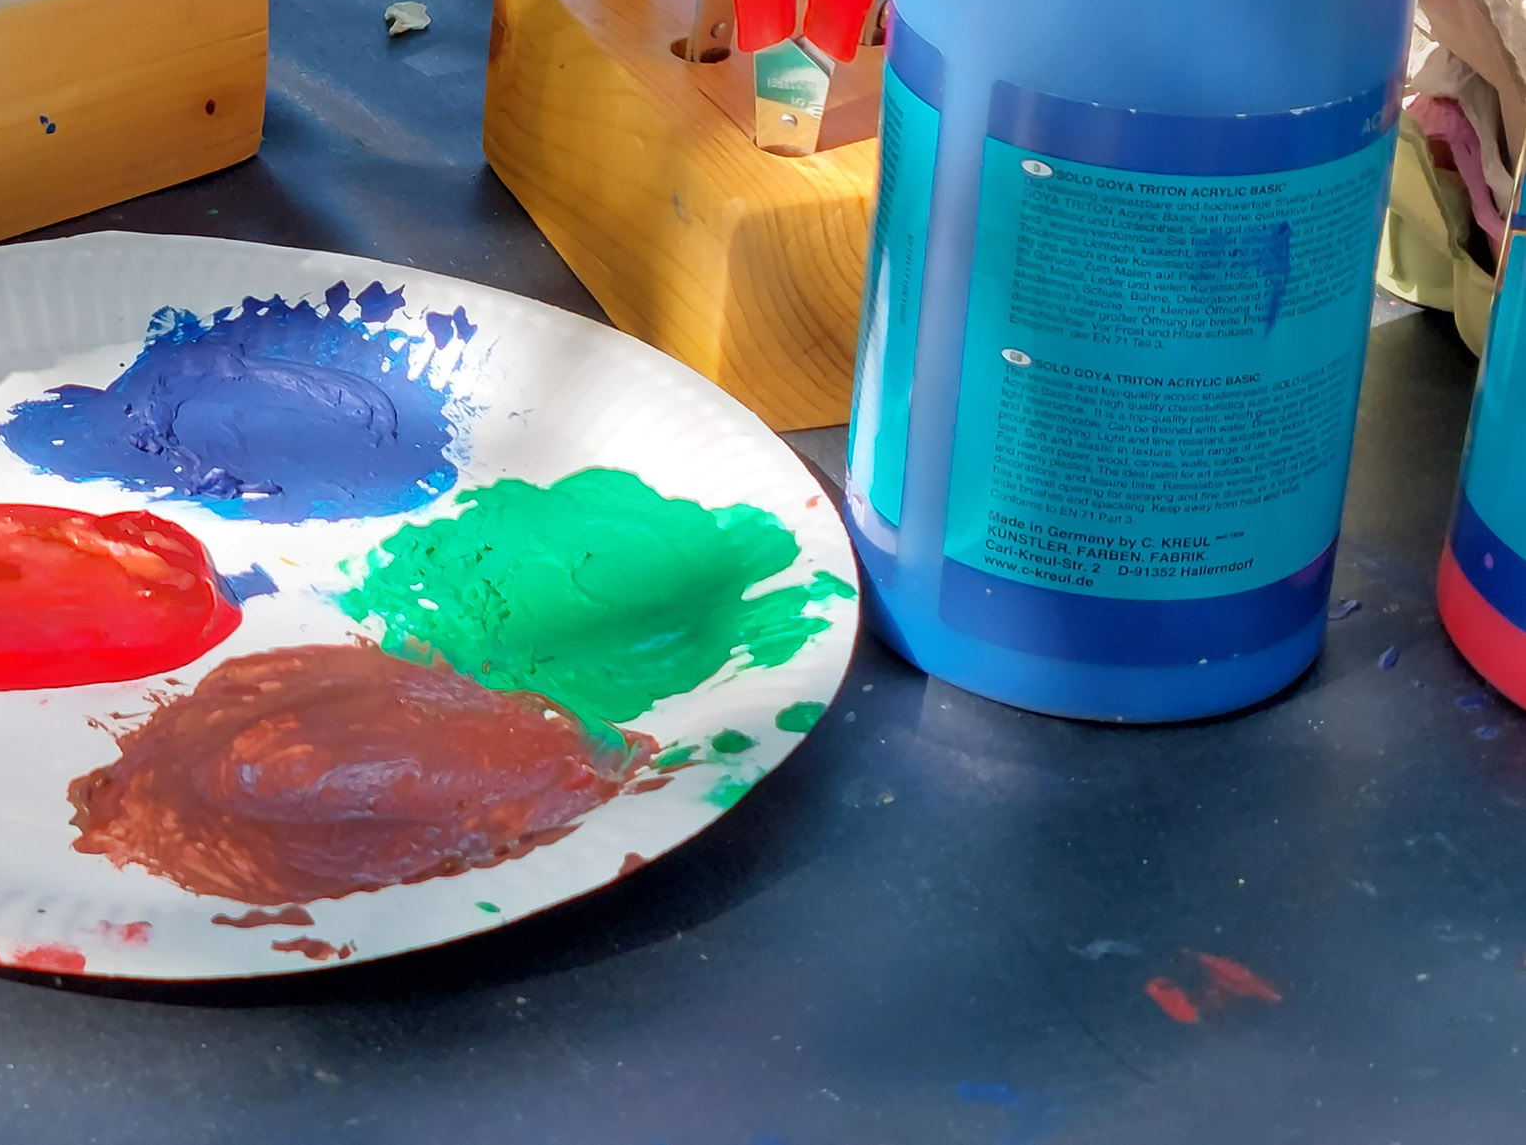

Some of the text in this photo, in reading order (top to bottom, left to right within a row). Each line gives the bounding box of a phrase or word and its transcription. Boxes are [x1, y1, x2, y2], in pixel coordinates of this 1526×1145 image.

[1055, 169, 1286, 196] SOLO GOYA TRITON ACRYLIC BASIC
[1023, 188, 1251, 222] GOYA TRITON Acrylic Basic hat hohe
[1178, 200, 1199, 211] und
[1088, 215, 1110, 226] und
[1225, 225, 1241, 235] gut
[1167, 237, 1186, 245] Sie
[1083, 261, 1111, 273] Zum
[1115, 266, 1151, 277] Malen
[1155, 270, 1174, 279] auf
[1096, 252, 1107, 261] in
[1109, 254, 1129, 263] der
[1090, 274, 1188, 291] Leder und vielen
[1137, 303, 1155, 313] mit
[1160, 305, 1199, 314] kleiner
[1205, 303, 1249, 316] Öffnung
[1141, 314, 1187, 327] Öffnung
[1091, 321, 1112, 331] Vor
[1114, 324, 1144, 335] Frost
[1147, 327, 1170, 336] und
[1092, 332, 1110, 344] EN
[1113, 335, 1128, 346] 71
[1133, 337, 1152, 348] Teil
[1005, 365, 1200, 401] The and top-quality acrylic
[1033, 358, 1260, 387] SOLO GOYA TRITON ACRYLIC BASIC
[1000, 387, 1022, 402] light
[1094, 407, 1102, 417] It
[1105, 409, 1115, 418] is
[1118, 410, 1125, 419] a
[1128, 412, 1188, 424] top-quality
[1074, 394, 1096, 405] has
[1099, 397, 1124, 408] high
[1128, 400, 1162, 411] quality
[998, 409, 1025, 426] proof
[1028, 419, 1053, 433] after
[1097, 431, 1124, 442] Light
[1128, 434, 1149, 444] and
[1152, 436, 1175, 445] lime
[999, 399, 1019, 413] and
[1108, 421, 1131, 431] Can
[1134, 424, 1148, 432] be
[1151, 425, 1192, 434] thinned
[1195, 426, 1216, 434] with
[996, 431, 1014, 445] For
[1017, 438, 1038, 452] use
[1040, 444, 1054, 455] on
[1024, 429, 1045, 441] Soft
[1050, 435, 1072, 446] and
[1117, 444, 1127, 452] in
[1178, 448, 1204, 456] Vast
[1208, 445, 1238, 455] range
[1241, 444, 1250, 453] of
[994, 442, 1210, 478] and many The ideal paint for art
[992, 464, 1011, 479] has
[1015, 472, 1022, 482] a
[1025, 475, 1055, 490] small
[1058, 482, 1104, 496] opening
[1107, 488, 1121, 498] for
[1124, 490, 1175, 501] spraying
[1177, 493, 1198, 501] and
[1201, 492, 1218, 501] fine
[1064, 471, 1087, 483] and
[1090, 475, 1128, 487] leisure
[992, 476, 1016, 492] wide
[1019, 485, 1062, 502] brushes
[1065, 494, 1088, 505] and
[1151, 502, 1181, 512] Keep
[1183, 503, 1211, 512] away
[1214, 500, 1238, 511] from
[1044, 504, 1057, 515] to
[1059, 507, 1078, 518] EN
[1081, 510, 1095, 520] 71
[1099, 512, 1122, 522] Part
[987, 520, 1210, 563] KÜNSTLER. FARBEN. FABRIK.
[988, 507, 1211, 550] Made in Germany by C. KREUL
[984, 537, 1254, 578] Carl-Kreul-Str. 2 D-91352 Hallerndorf
[984, 552, 1095, 587] www.c-kreul.de
